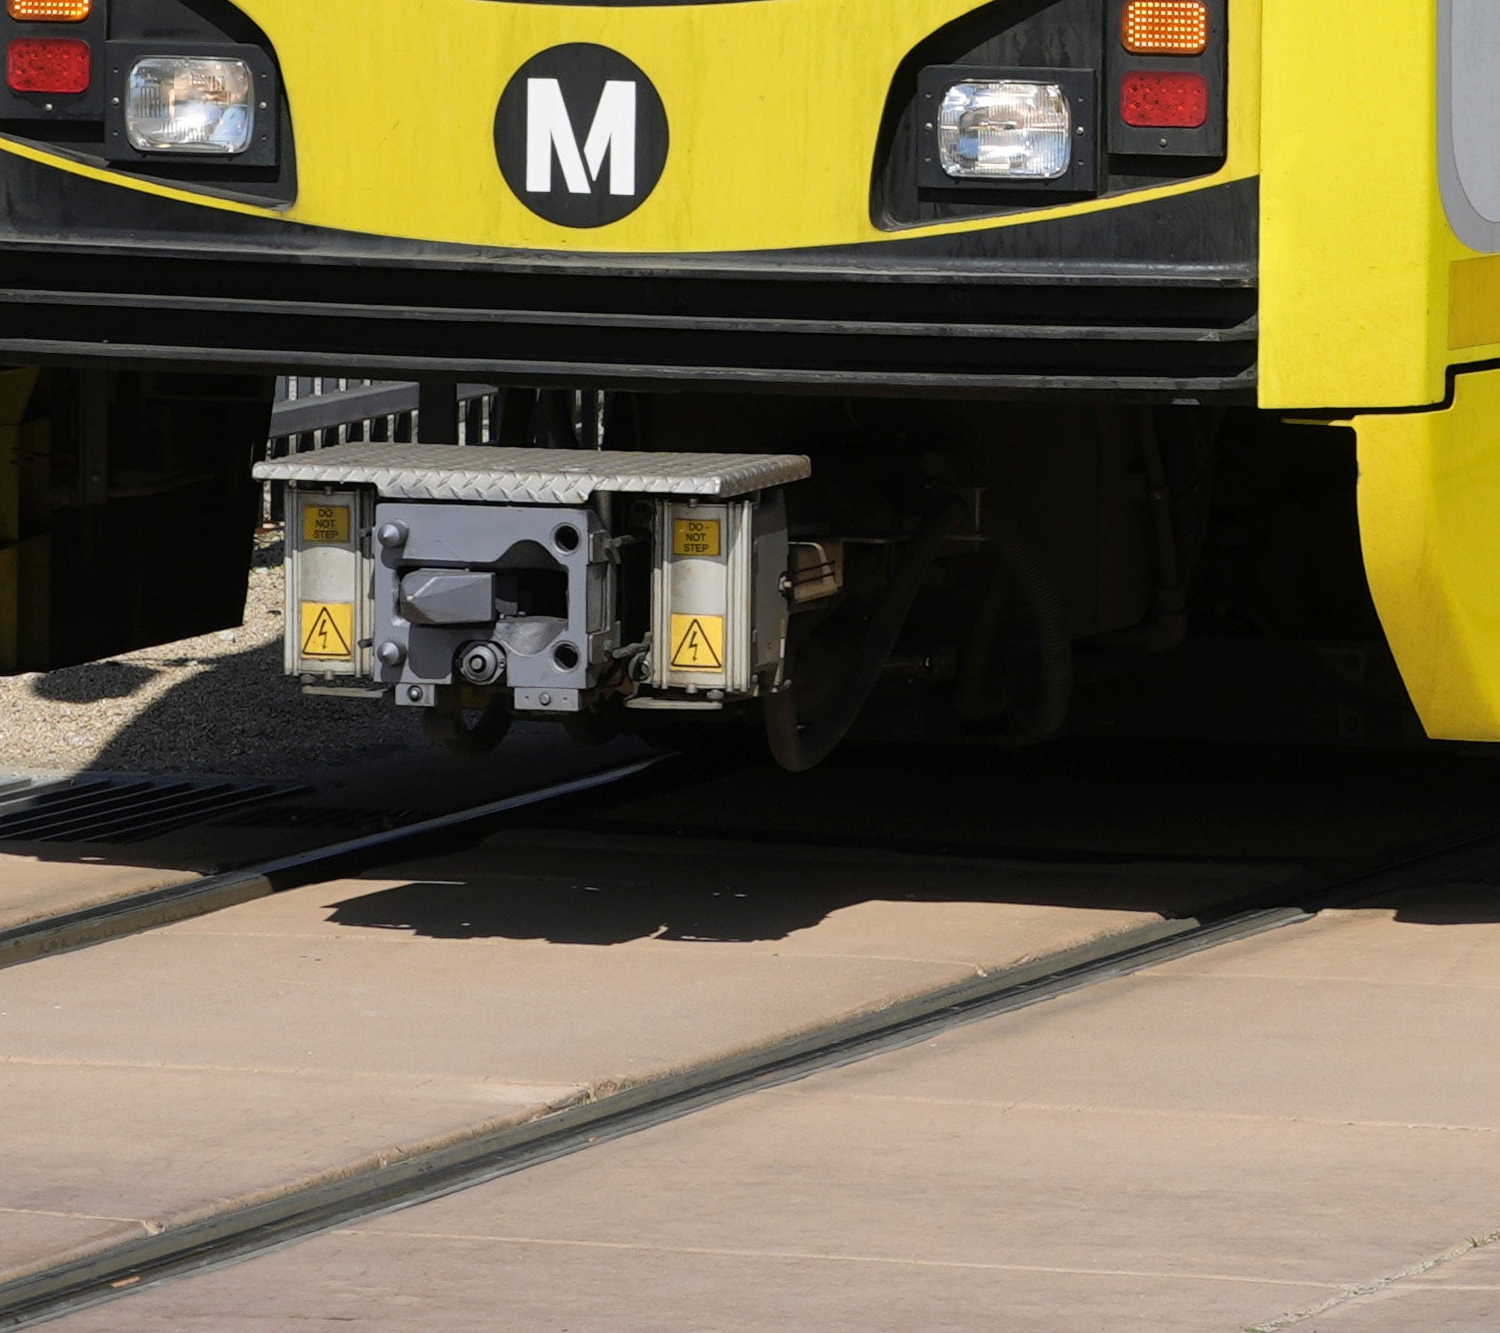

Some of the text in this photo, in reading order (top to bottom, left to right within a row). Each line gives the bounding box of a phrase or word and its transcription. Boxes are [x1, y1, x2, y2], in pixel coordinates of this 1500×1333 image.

[525, 77, 637, 195] M
[318, 509, 333, 517] DO
[315, 519, 336, 528] NOT
[689, 522, 703, 531] DO
[313, 530, 339, 539] STEP
[686, 533, 706, 542] NOT
[683, 543, 709, 552] STEP
